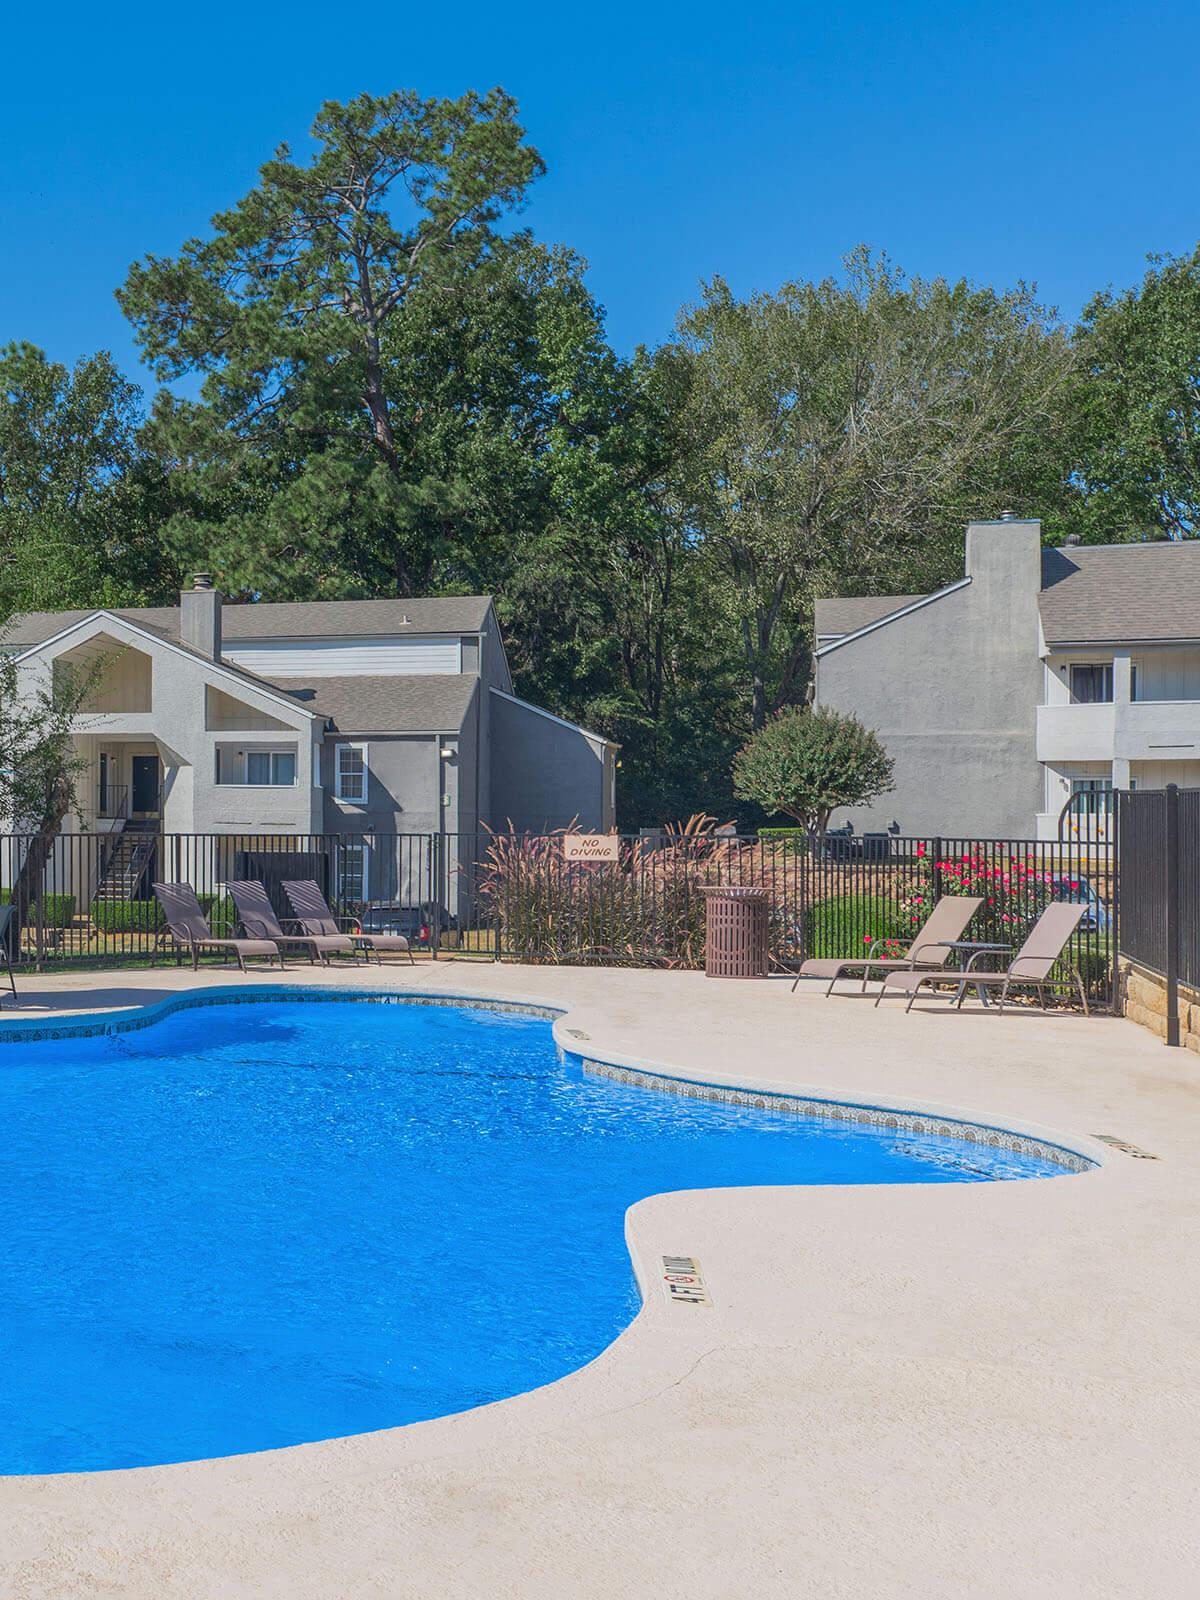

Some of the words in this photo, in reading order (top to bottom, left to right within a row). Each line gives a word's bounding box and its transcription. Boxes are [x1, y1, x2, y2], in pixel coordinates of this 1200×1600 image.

[582, 839, 600, 847] NO
[569, 847, 612, 857] DIVING
[670, 1284, 705, 1296] FT
